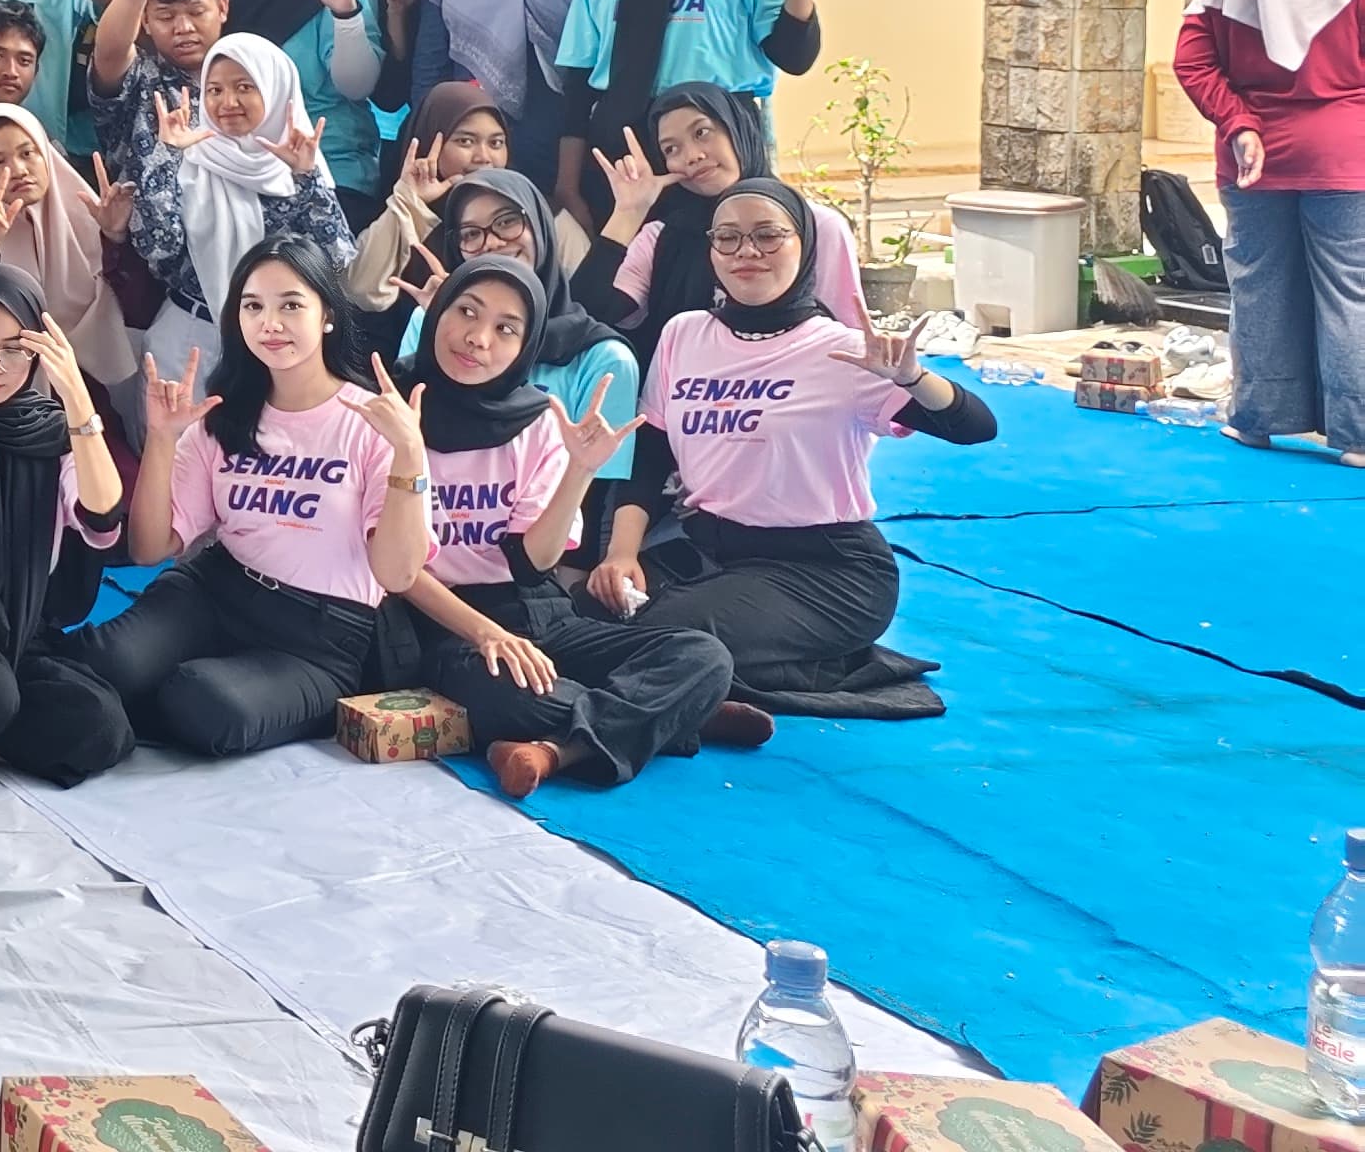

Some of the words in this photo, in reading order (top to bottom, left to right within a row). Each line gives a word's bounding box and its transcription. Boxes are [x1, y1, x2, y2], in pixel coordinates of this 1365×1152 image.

[671, 377, 795, 401] SENANG
[681, 409, 764, 435] UANG
[218, 453, 349, 484] SENANG
[229, 484, 321, 519] UANG
[1315, 1014, 1332, 1038] Le
